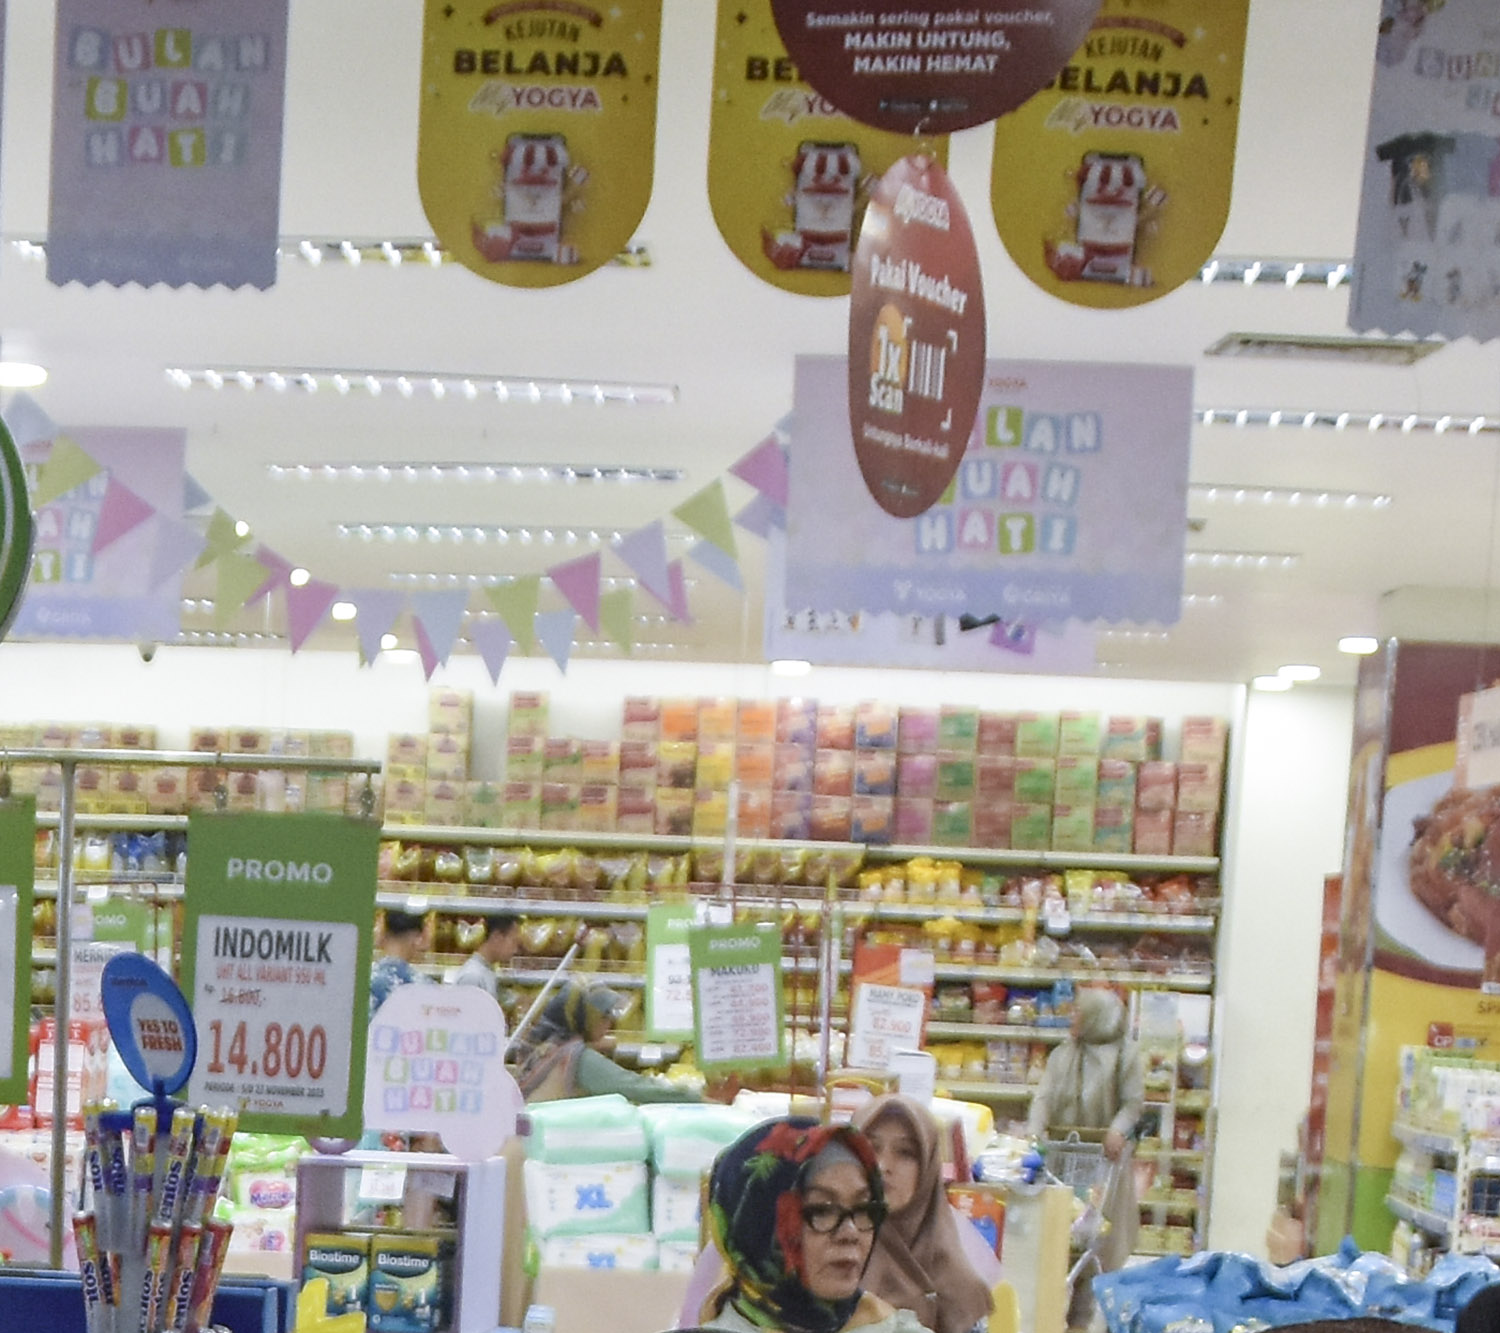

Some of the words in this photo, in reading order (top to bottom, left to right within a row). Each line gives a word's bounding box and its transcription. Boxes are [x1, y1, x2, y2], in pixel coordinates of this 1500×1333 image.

[504, 17, 579, 45] KEJUTAN
[806, 10, 876, 28] Semakin
[881, 12, 929, 30] sering
[934, 10, 983, 29] pakai
[69, 27, 270, 70] BULAN
[845, 32, 912, 51] MAKIN
[918, 30, 1011, 52] UNTUNG,
[1084, 36, 1164, 64] KEJUTAN
[454, 48, 628, 79] BELANJA
[854, 55, 921, 74] MAKIN
[927, 53, 999, 73] HEMAT
[1041, 65, 1209, 100] BELANJA
[512, 84, 601, 111] YOGYA
[1088, 104, 1179, 133] YOGYA
[909, 260, 968, 316] Voucher
[916, 508, 1078, 555] HATI
[226, 857, 333, 884] PROMO
[213, 925, 334, 965] INDOMILK
[708, 936, 762, 951] PROMO
[137, 1016, 162, 1034] YES
[162, 1017, 178, 1034] TO
[141, 1033, 184, 1053] FRESH
[206, 1018, 328, 1080] 14.800
[309, 1248, 361, 1266] Biostime
[377, 1252, 430, 1269] Biostime
